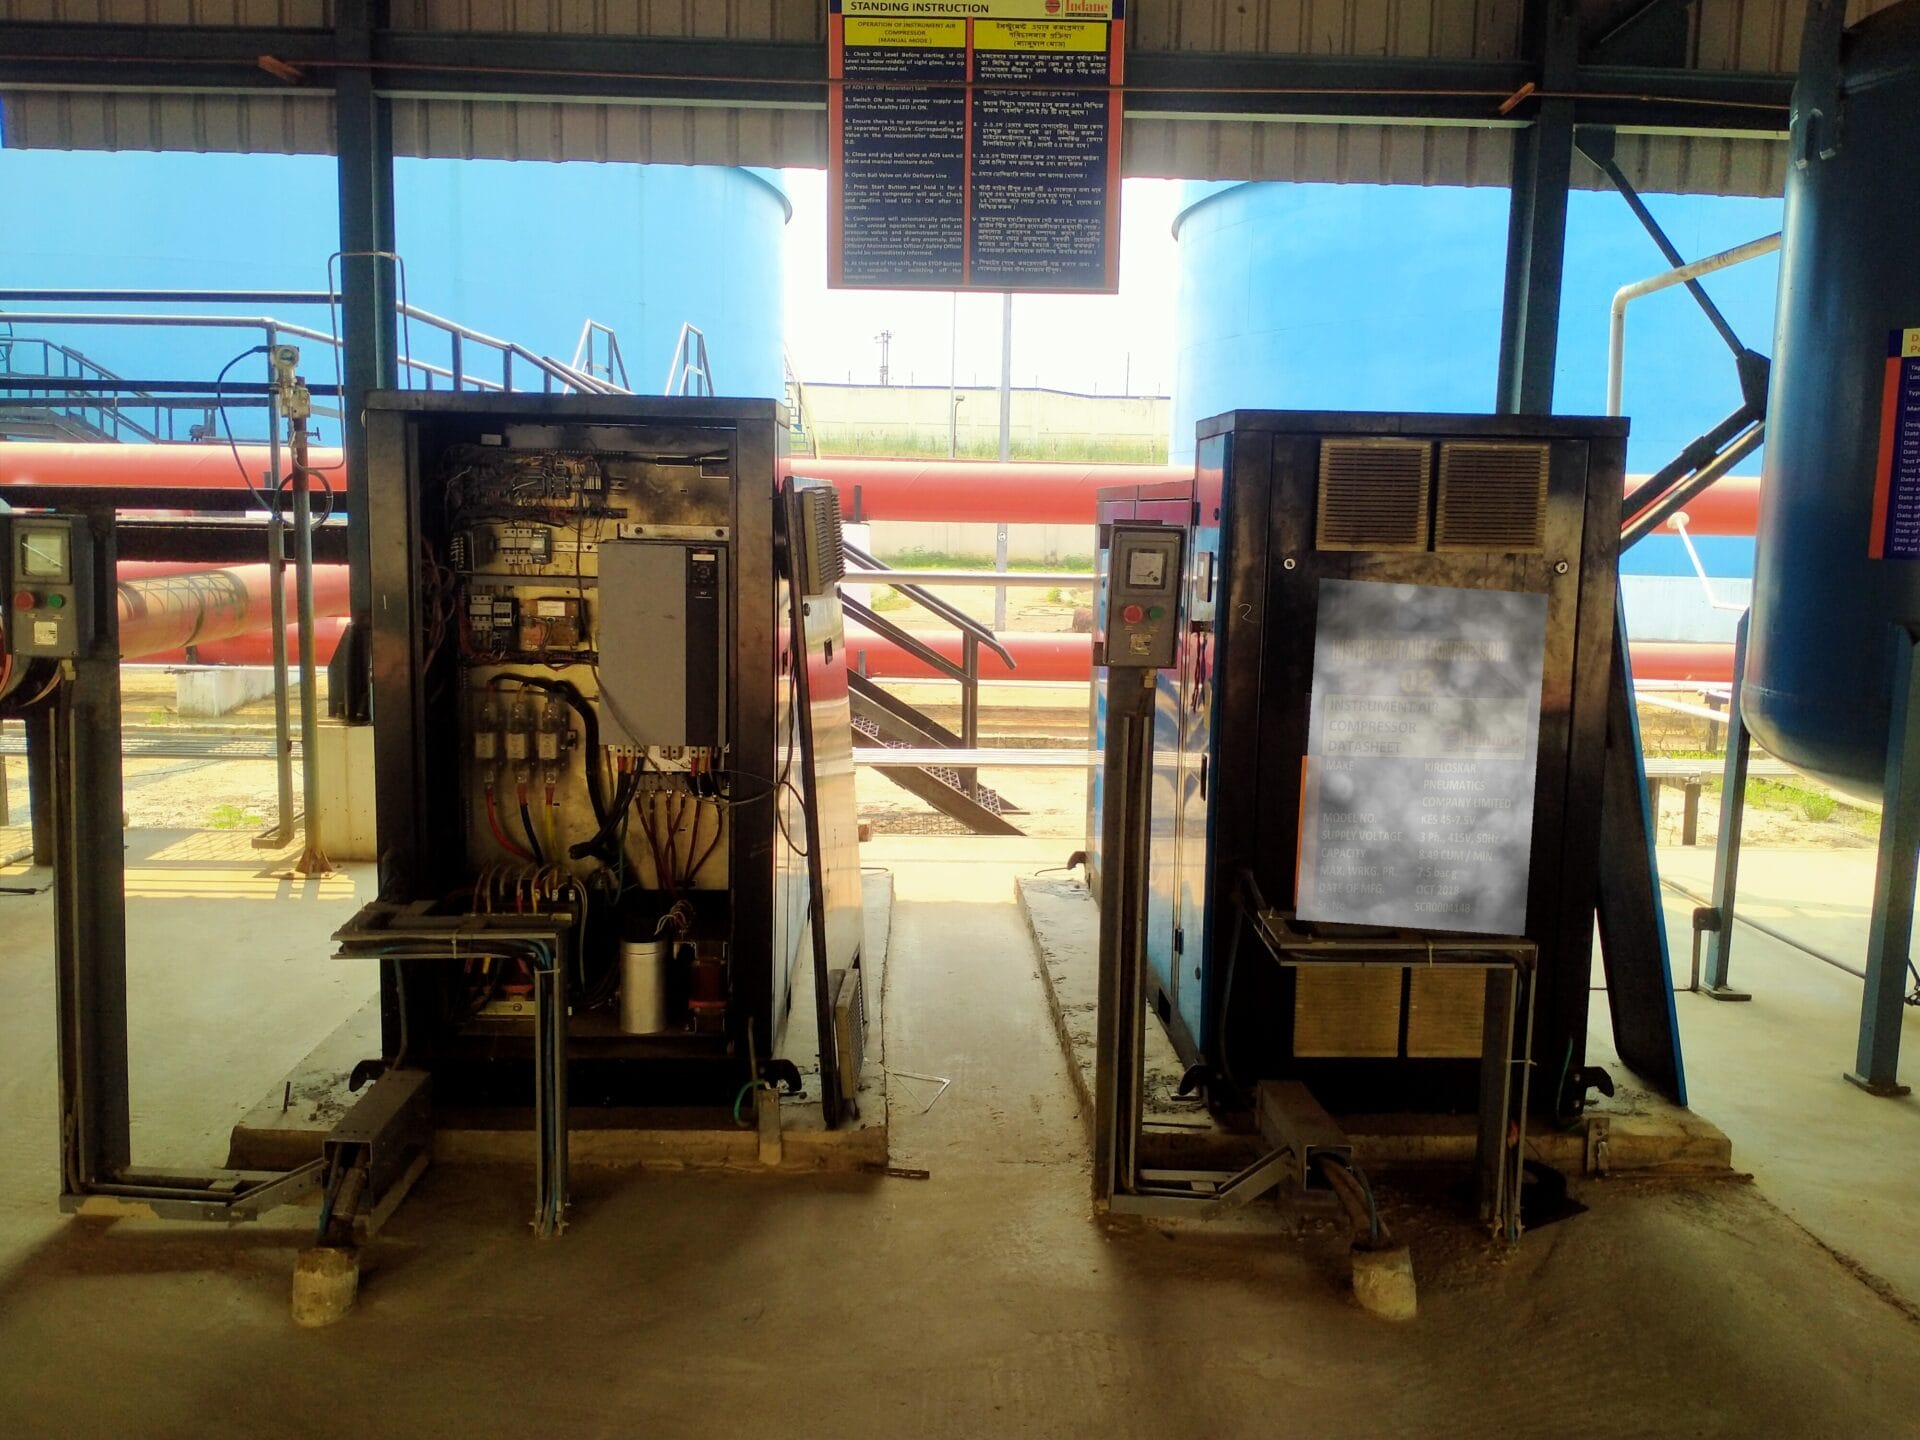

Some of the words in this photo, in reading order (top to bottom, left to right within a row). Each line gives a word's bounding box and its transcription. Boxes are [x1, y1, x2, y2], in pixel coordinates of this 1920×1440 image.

[851, 2, 909, 11] STANDING
[913, 3, 988, 12] INSTRUCTION
[1065, 0, 1108, 12] Indane
[1332, 640, 1404, 661] INSTRUMENT
[1408, 640, 1424, 661] AIR
[1428, 640, 1505, 662] COMPRESSOR
[1400, 670, 1435, 692] 02
[1330, 700, 1413, 712] INSTRUMENT
[1418, 700, 1439, 713] AIR
[1329, 720, 1416, 734] COMPRESSOR
[1328, 741, 1402, 753] DATASHEET
[1326, 760, 1355, 771] MAKE
[1424, 762, 1476, 774] KIRLOSKAR
[1424, 780, 1486, 791] PNEUMATICS
[1422, 797, 1471, 808] COMPANY
[1474, 799, 1512, 808] LIMITED
[1323, 813, 1358, 823] MODEL
[1422, 816, 1438, 824] KES
[1321, 830, 1357, 840] SUPPLY
[1359, 831, 1402, 841] VOLTAGE
[1321, 848, 1366, 858] CAPACITY
